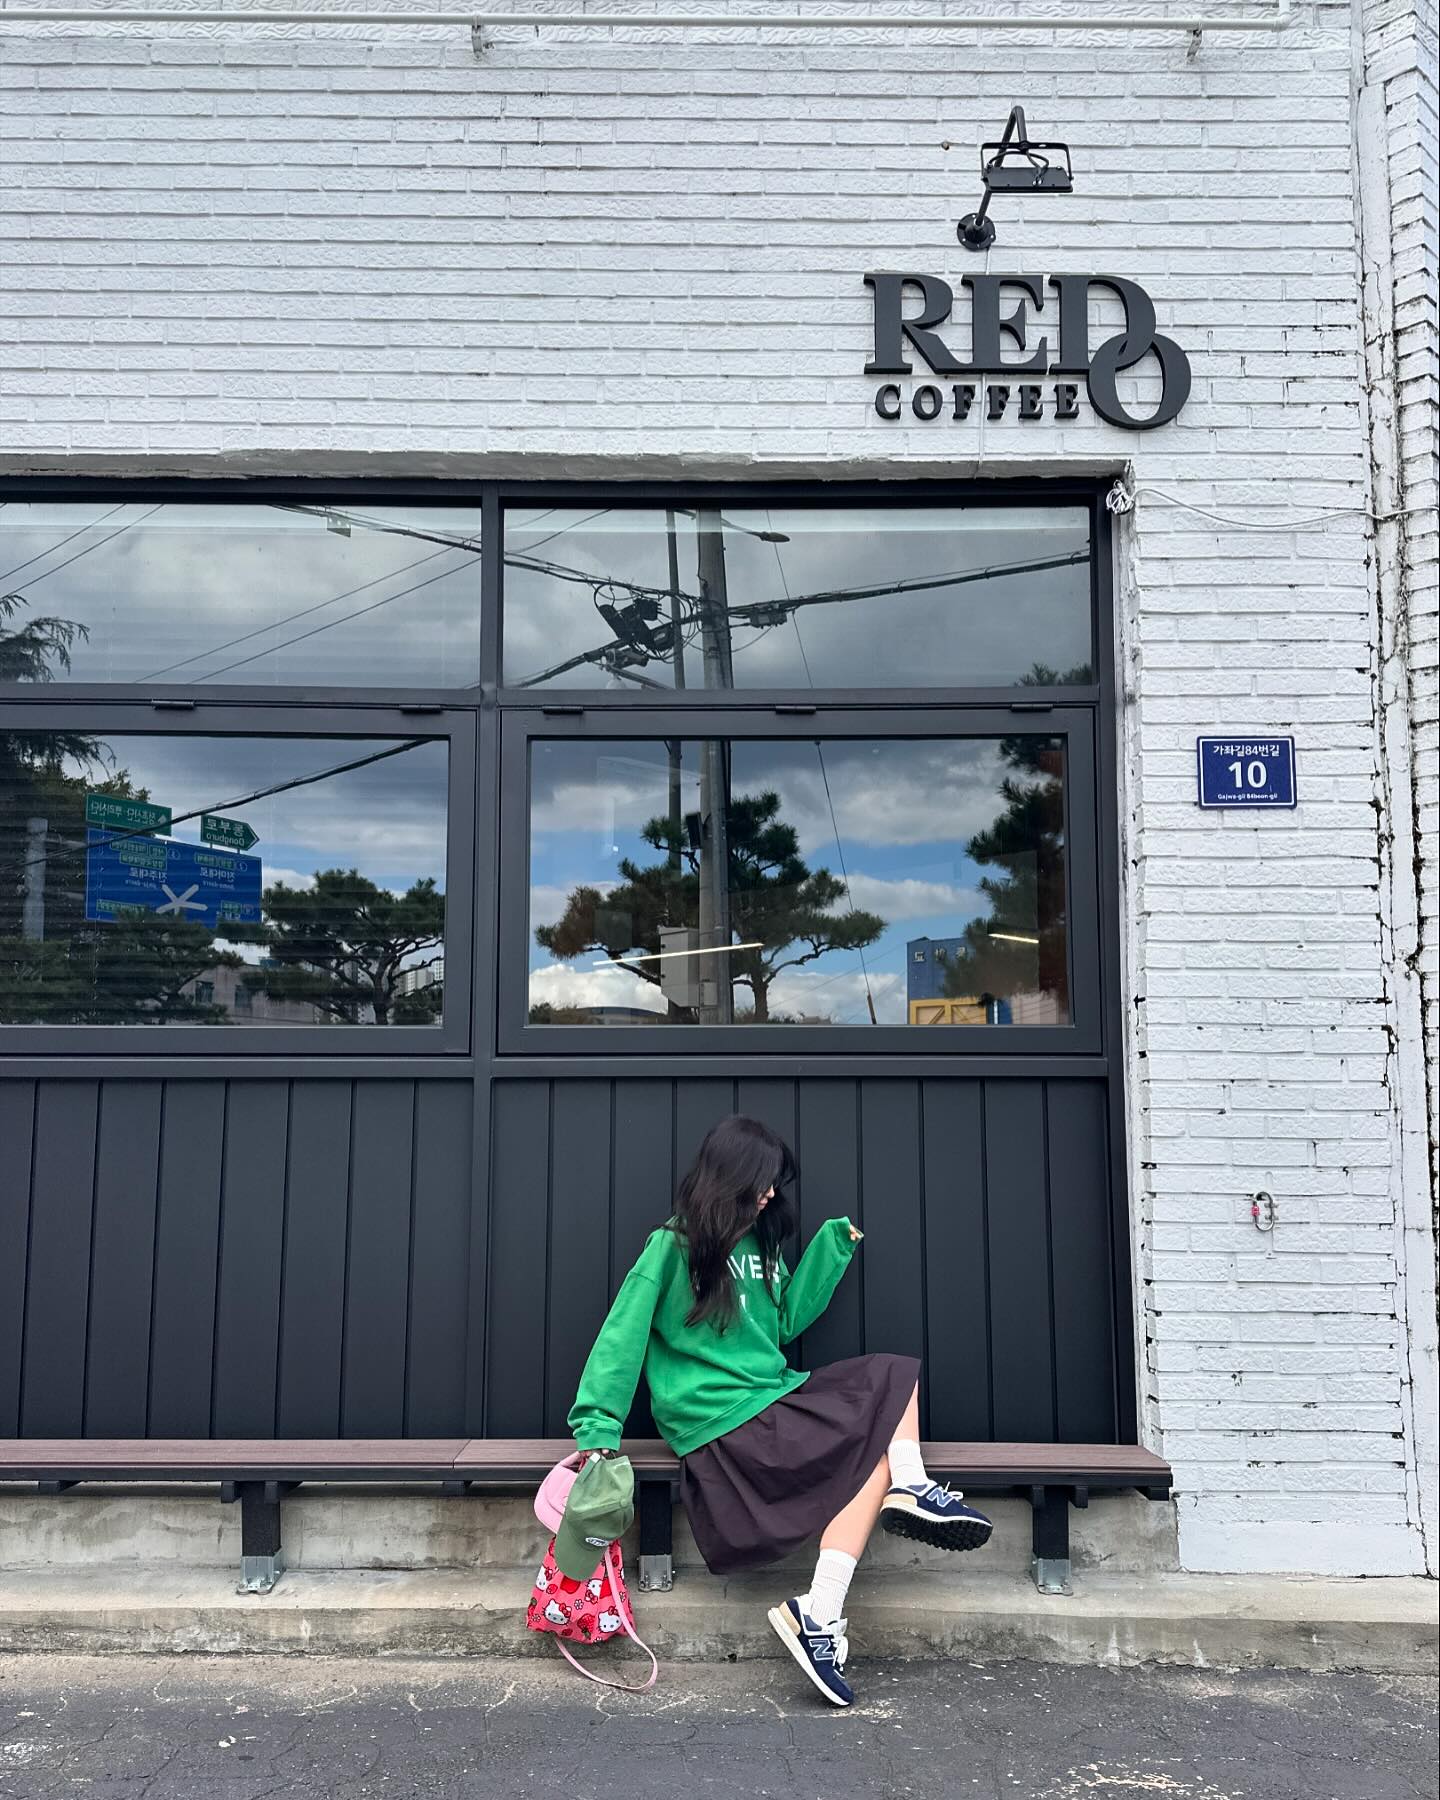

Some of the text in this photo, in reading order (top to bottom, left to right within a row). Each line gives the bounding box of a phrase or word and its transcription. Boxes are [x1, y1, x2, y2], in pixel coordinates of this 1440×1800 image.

[875, 384, 1080, 420] COFFEE
[1213, 744, 1280, 757] 가좌길84번길
[1228, 760, 1267, 788] 10
